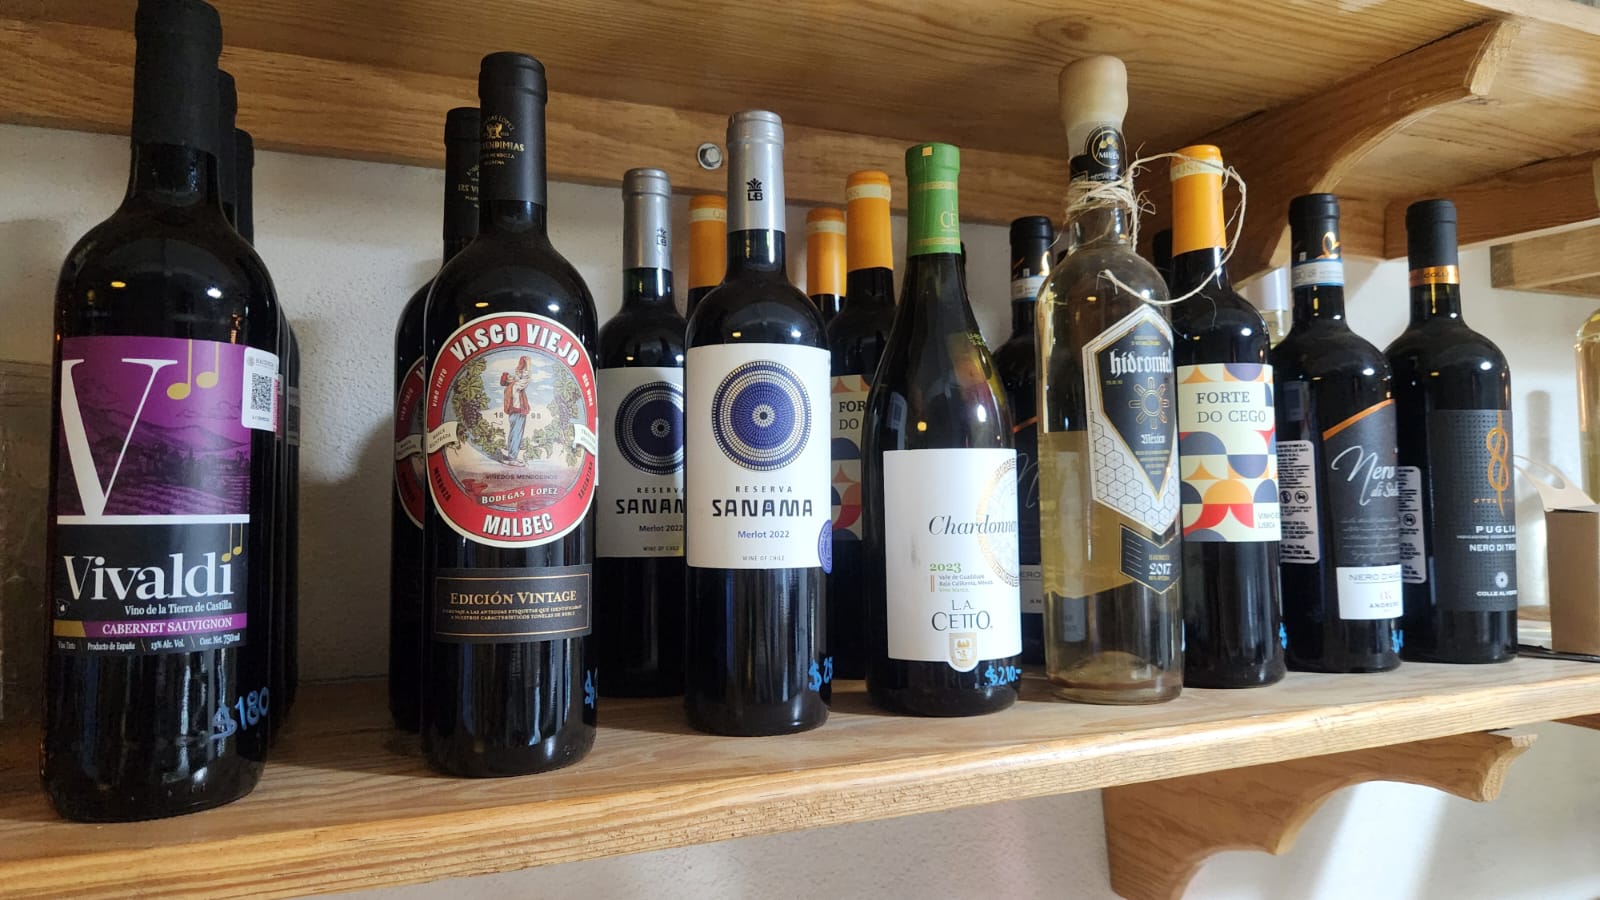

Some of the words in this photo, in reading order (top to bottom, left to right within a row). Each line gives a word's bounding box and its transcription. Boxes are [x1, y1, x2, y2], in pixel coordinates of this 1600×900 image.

[450, 322, 519, 362] VASCO
[526, 323, 580, 367] VIEJO
[1196, 391, 1250, 404] FORTE
[1197, 411, 1223, 423] DO
[1228, 410, 1266, 423] CEGO
[838, 418, 859, 430] DO
[735, 485, 793, 493] RESERVA
[481, 490, 525, 504] BODEGAS
[712, 499, 813, 517] SANAMA
[482, 512, 554, 537] MALBEC
[737, 530, 766, 538] Merlot
[769, 530, 790, 538] 2022
[1469, 543, 1496, 552] NERO
[929, 562, 962, 573] 2023
[1149, 562, 1173, 575] 2017
[63, 551, 234, 600] Vivaldi
[450, 590, 514, 605] EDICIÓN
[516, 590, 577, 605] VINTAGE
[125, 604, 145, 616] Vino
[146, 603, 157, 615] de
[158, 603, 167, 614] la
[168, 603, 194, 614] Tierra
[194, 601, 205, 612] de
[206, 599, 232, 611] Castilla
[102, 622, 166, 634] CABERNET
[167, 617, 233, 632] SAUVIGNON
[209, 686, 270, 740] $180
